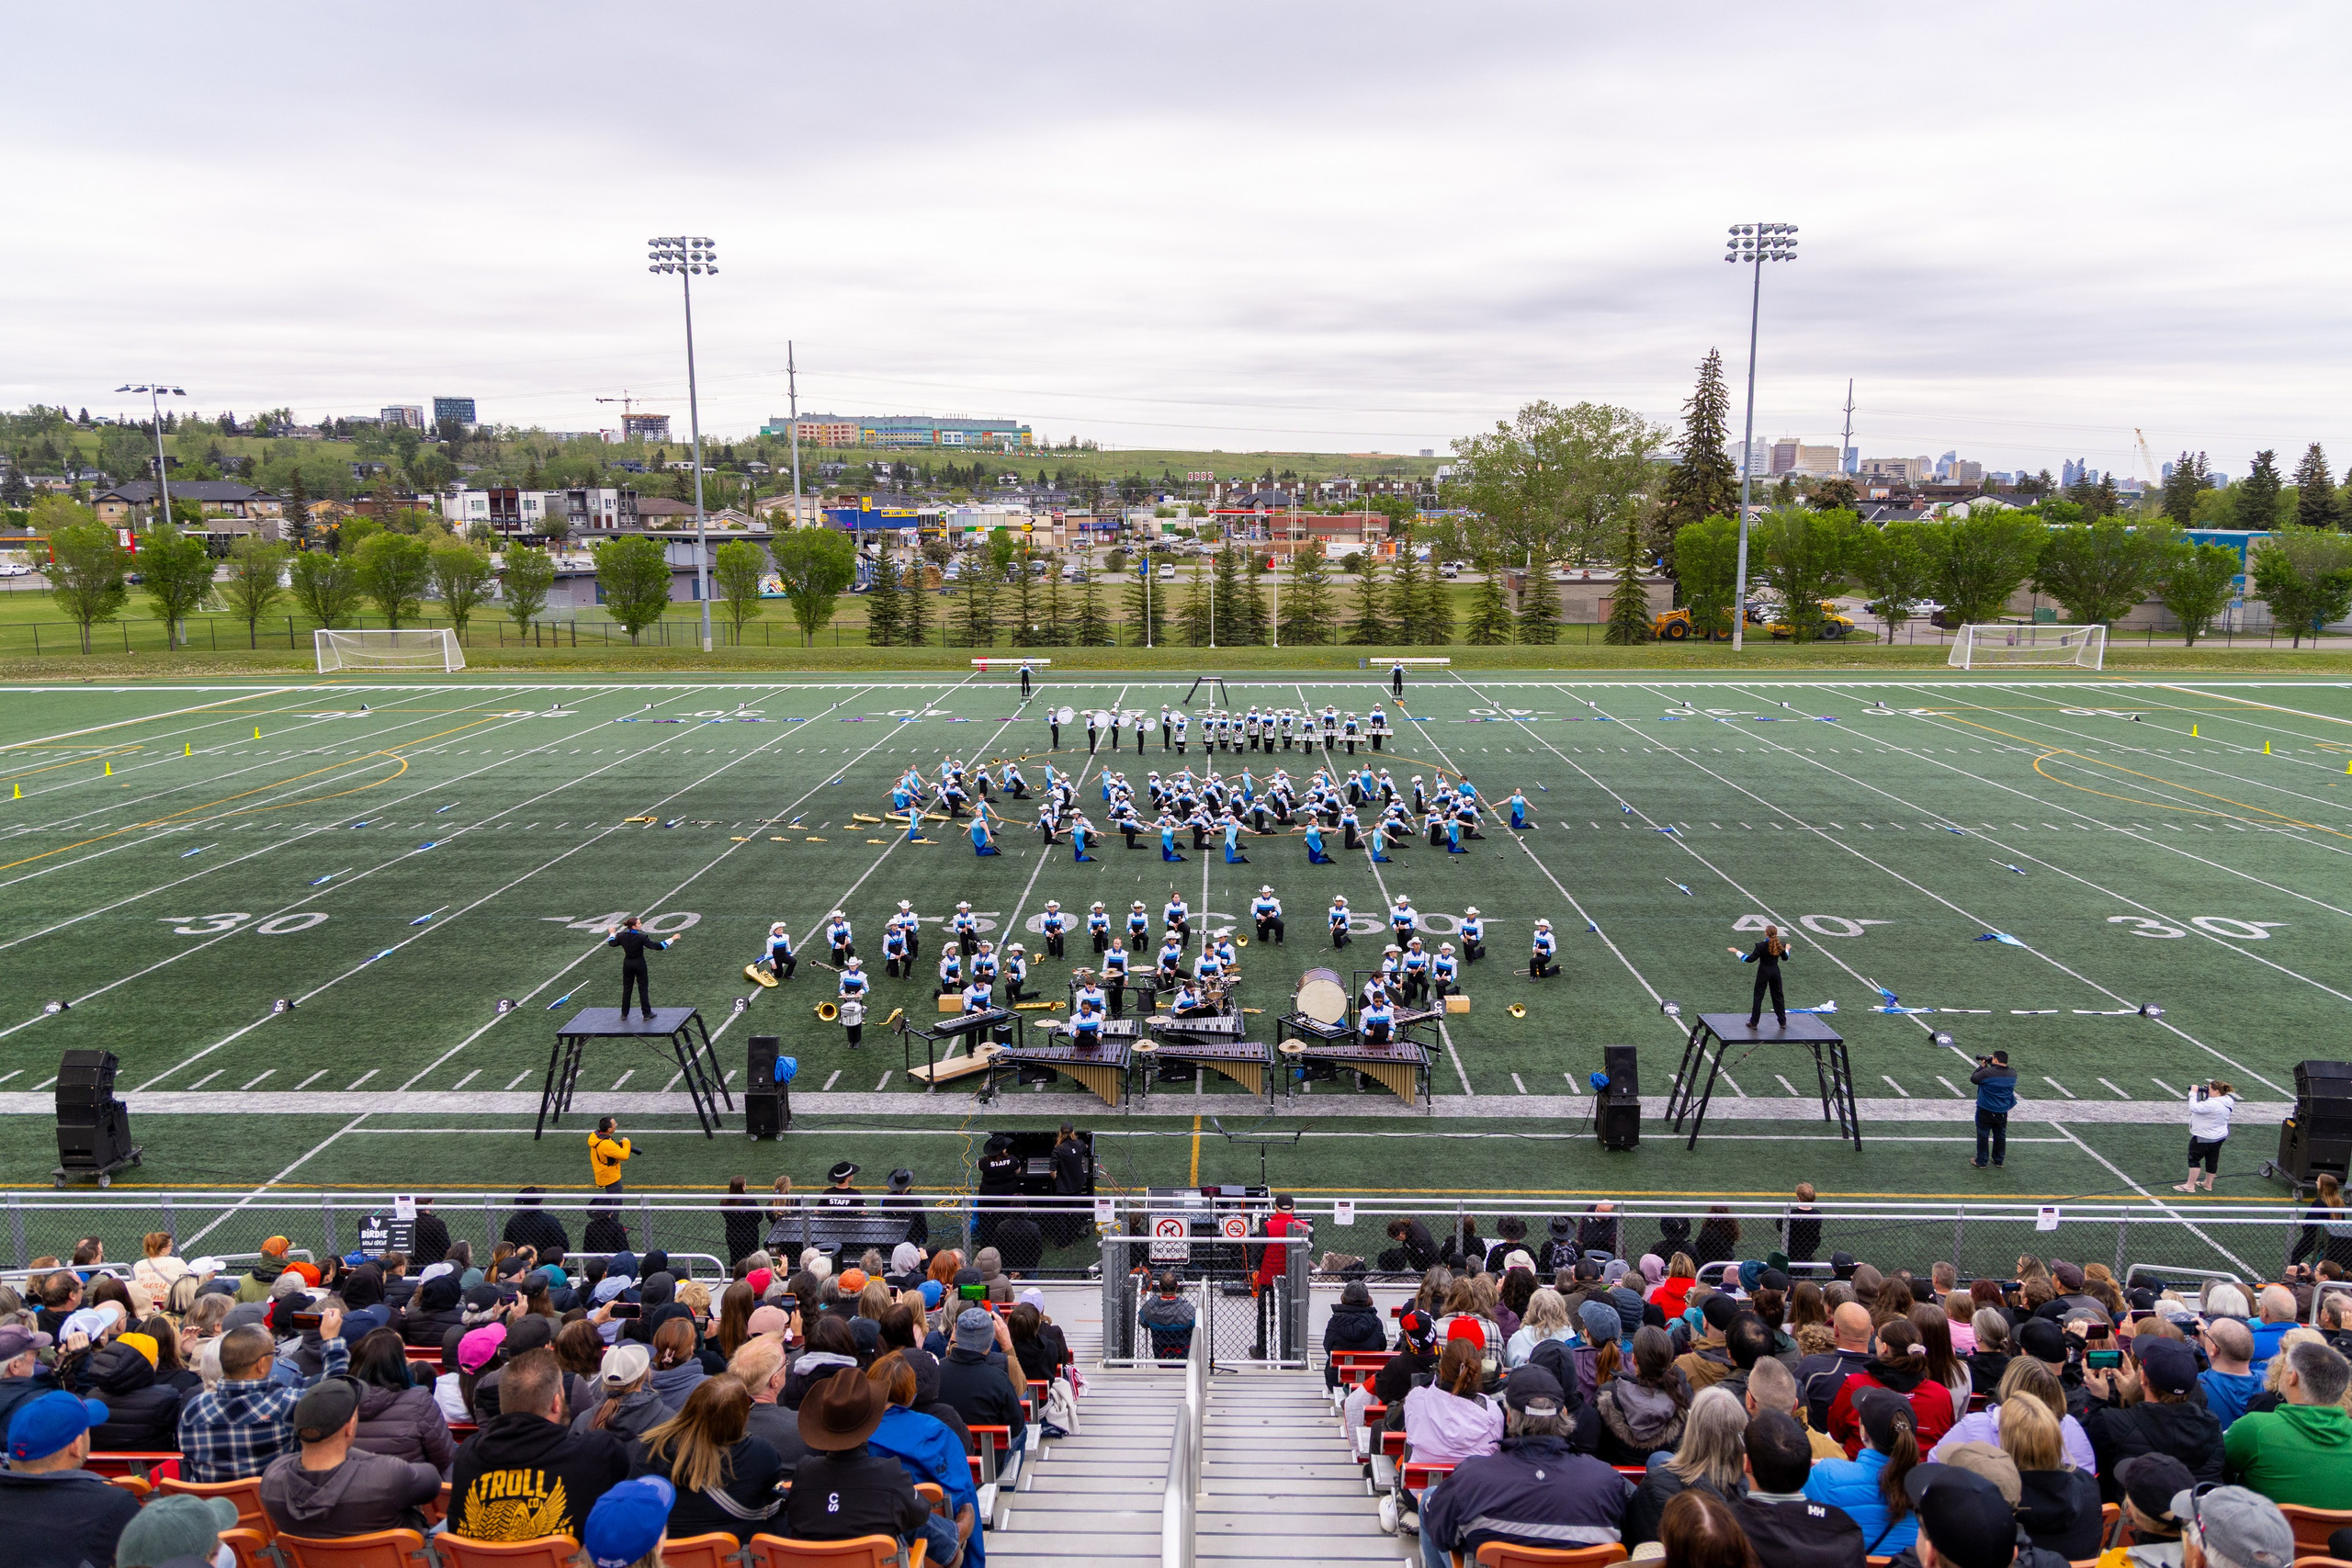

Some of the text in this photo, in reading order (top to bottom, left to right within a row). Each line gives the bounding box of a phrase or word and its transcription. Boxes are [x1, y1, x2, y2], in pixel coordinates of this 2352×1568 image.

[1188, 472, 1213, 480] ESSO
[174, 912, 329, 935] 30
[566, 912, 702, 934] 40
[1732, 914, 1866, 937] 40
[2108, 916, 2271, 939] 30
[989, 1158, 1012, 1168] STAFF
[829, 1198, 851, 1206] STAFF
[480, 1468, 548, 1501] TROLL
[527, 1497, 540, 1509] CO
[828, 1492, 840, 1512] CS
[1807, 1504, 1826, 1517] HH
